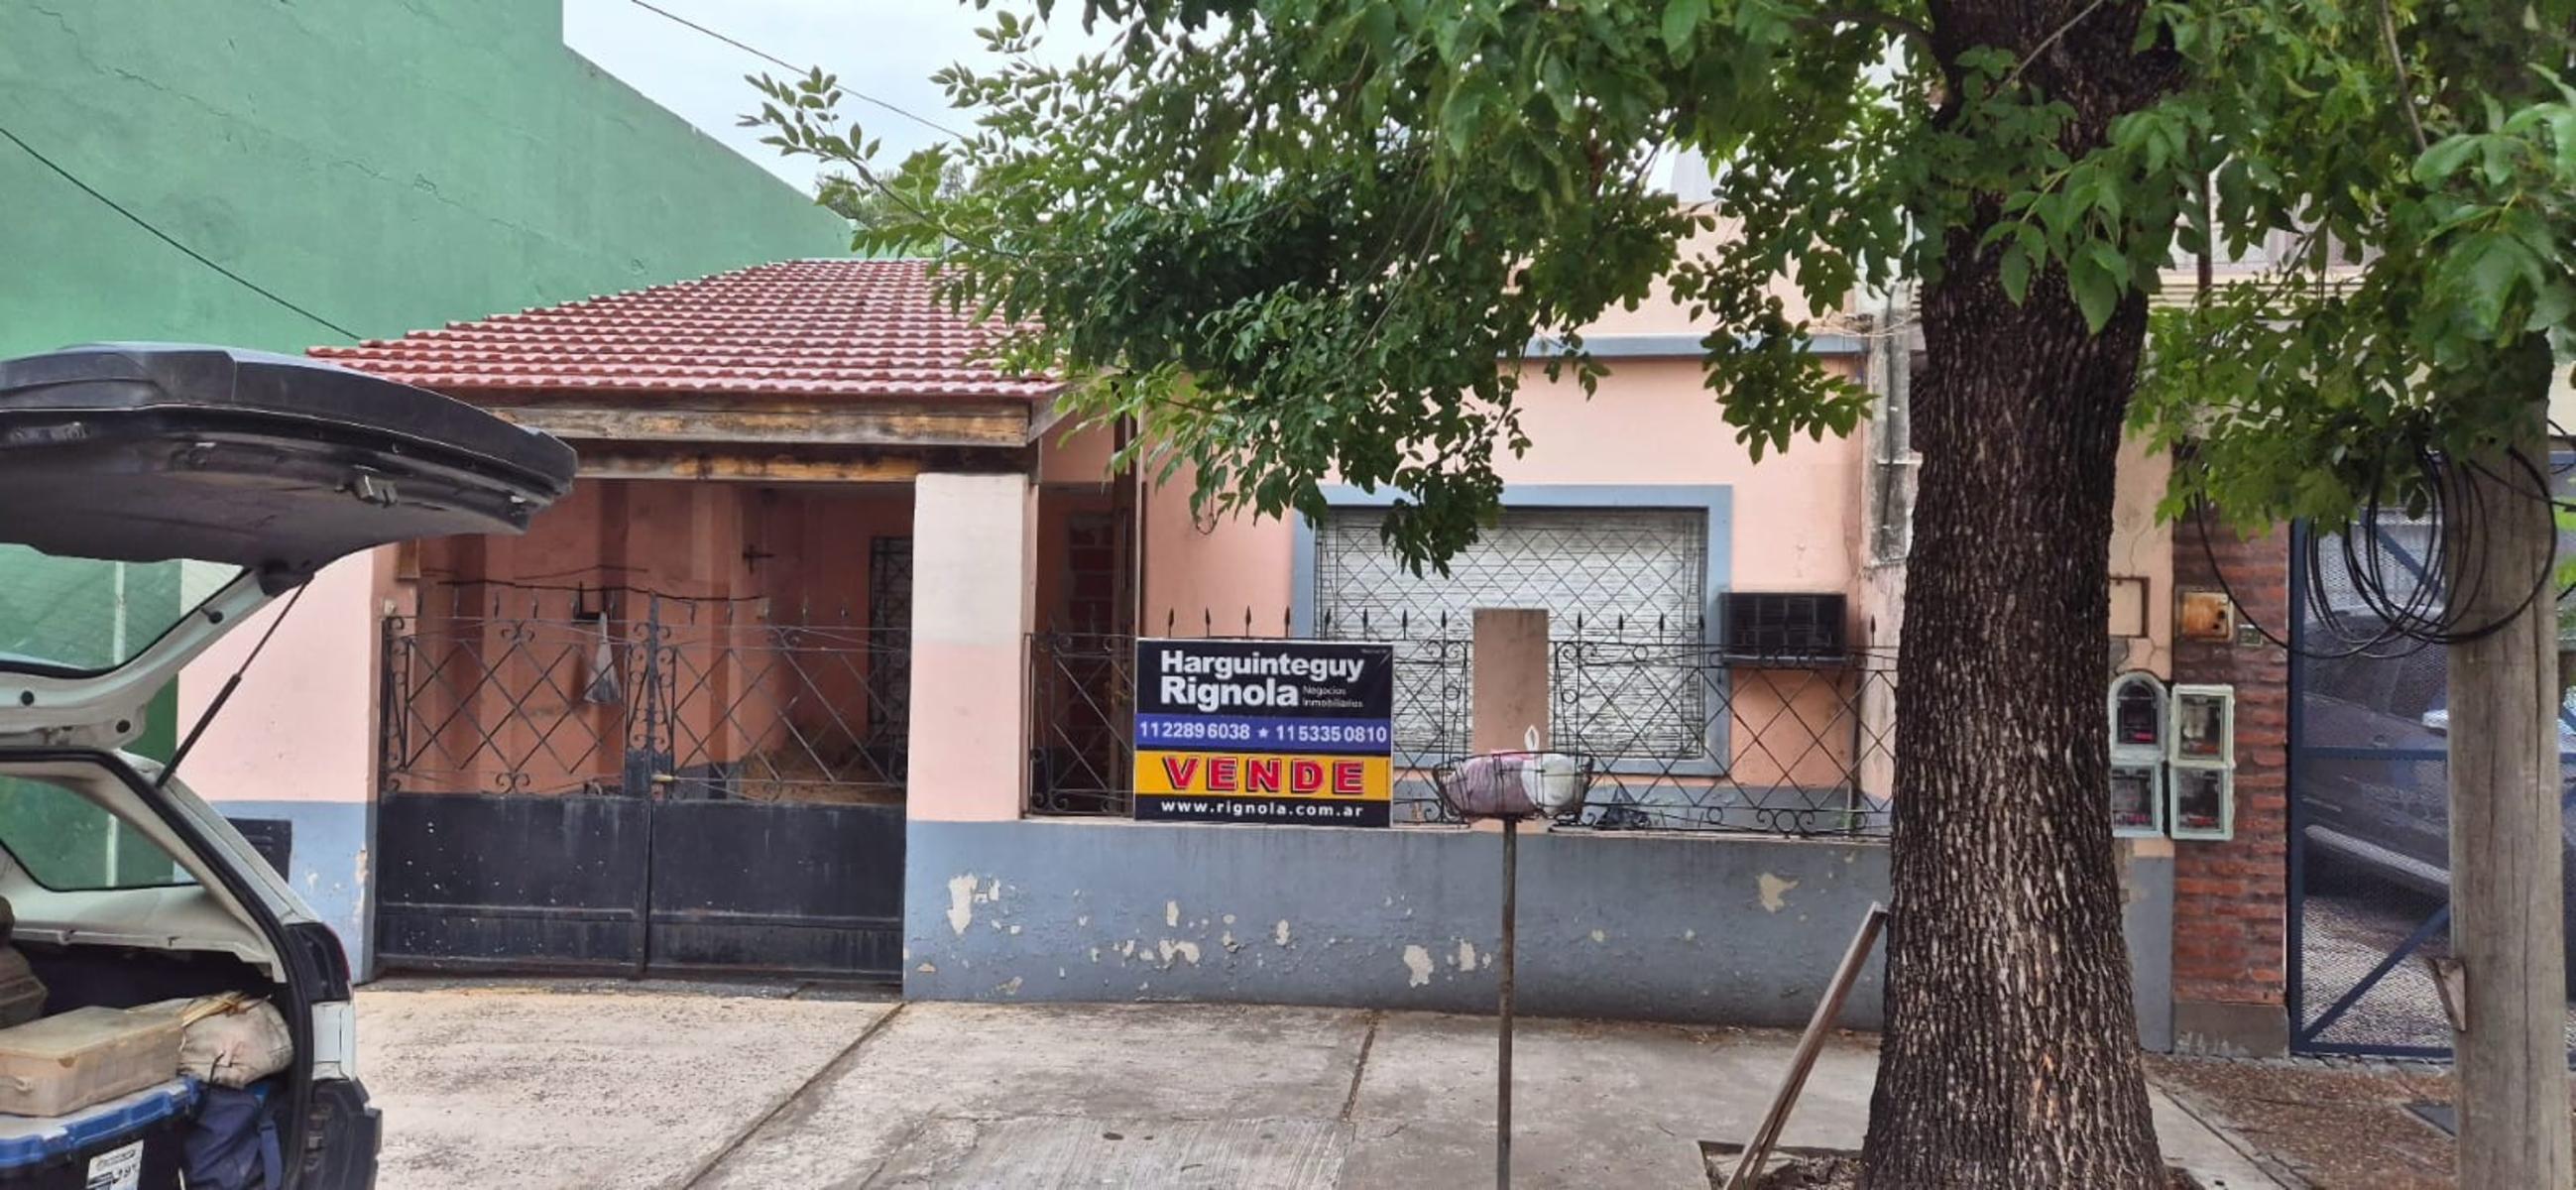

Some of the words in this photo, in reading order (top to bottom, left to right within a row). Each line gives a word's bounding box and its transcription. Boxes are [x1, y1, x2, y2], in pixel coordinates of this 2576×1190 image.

[1161, 650, 1364, 682] Harguinteguy
[1160, 675, 1299, 712] Rignola
[1163, 757, 1364, 793] VENDE
[1161, 799, 1364, 817] www.rignola.com.ar
